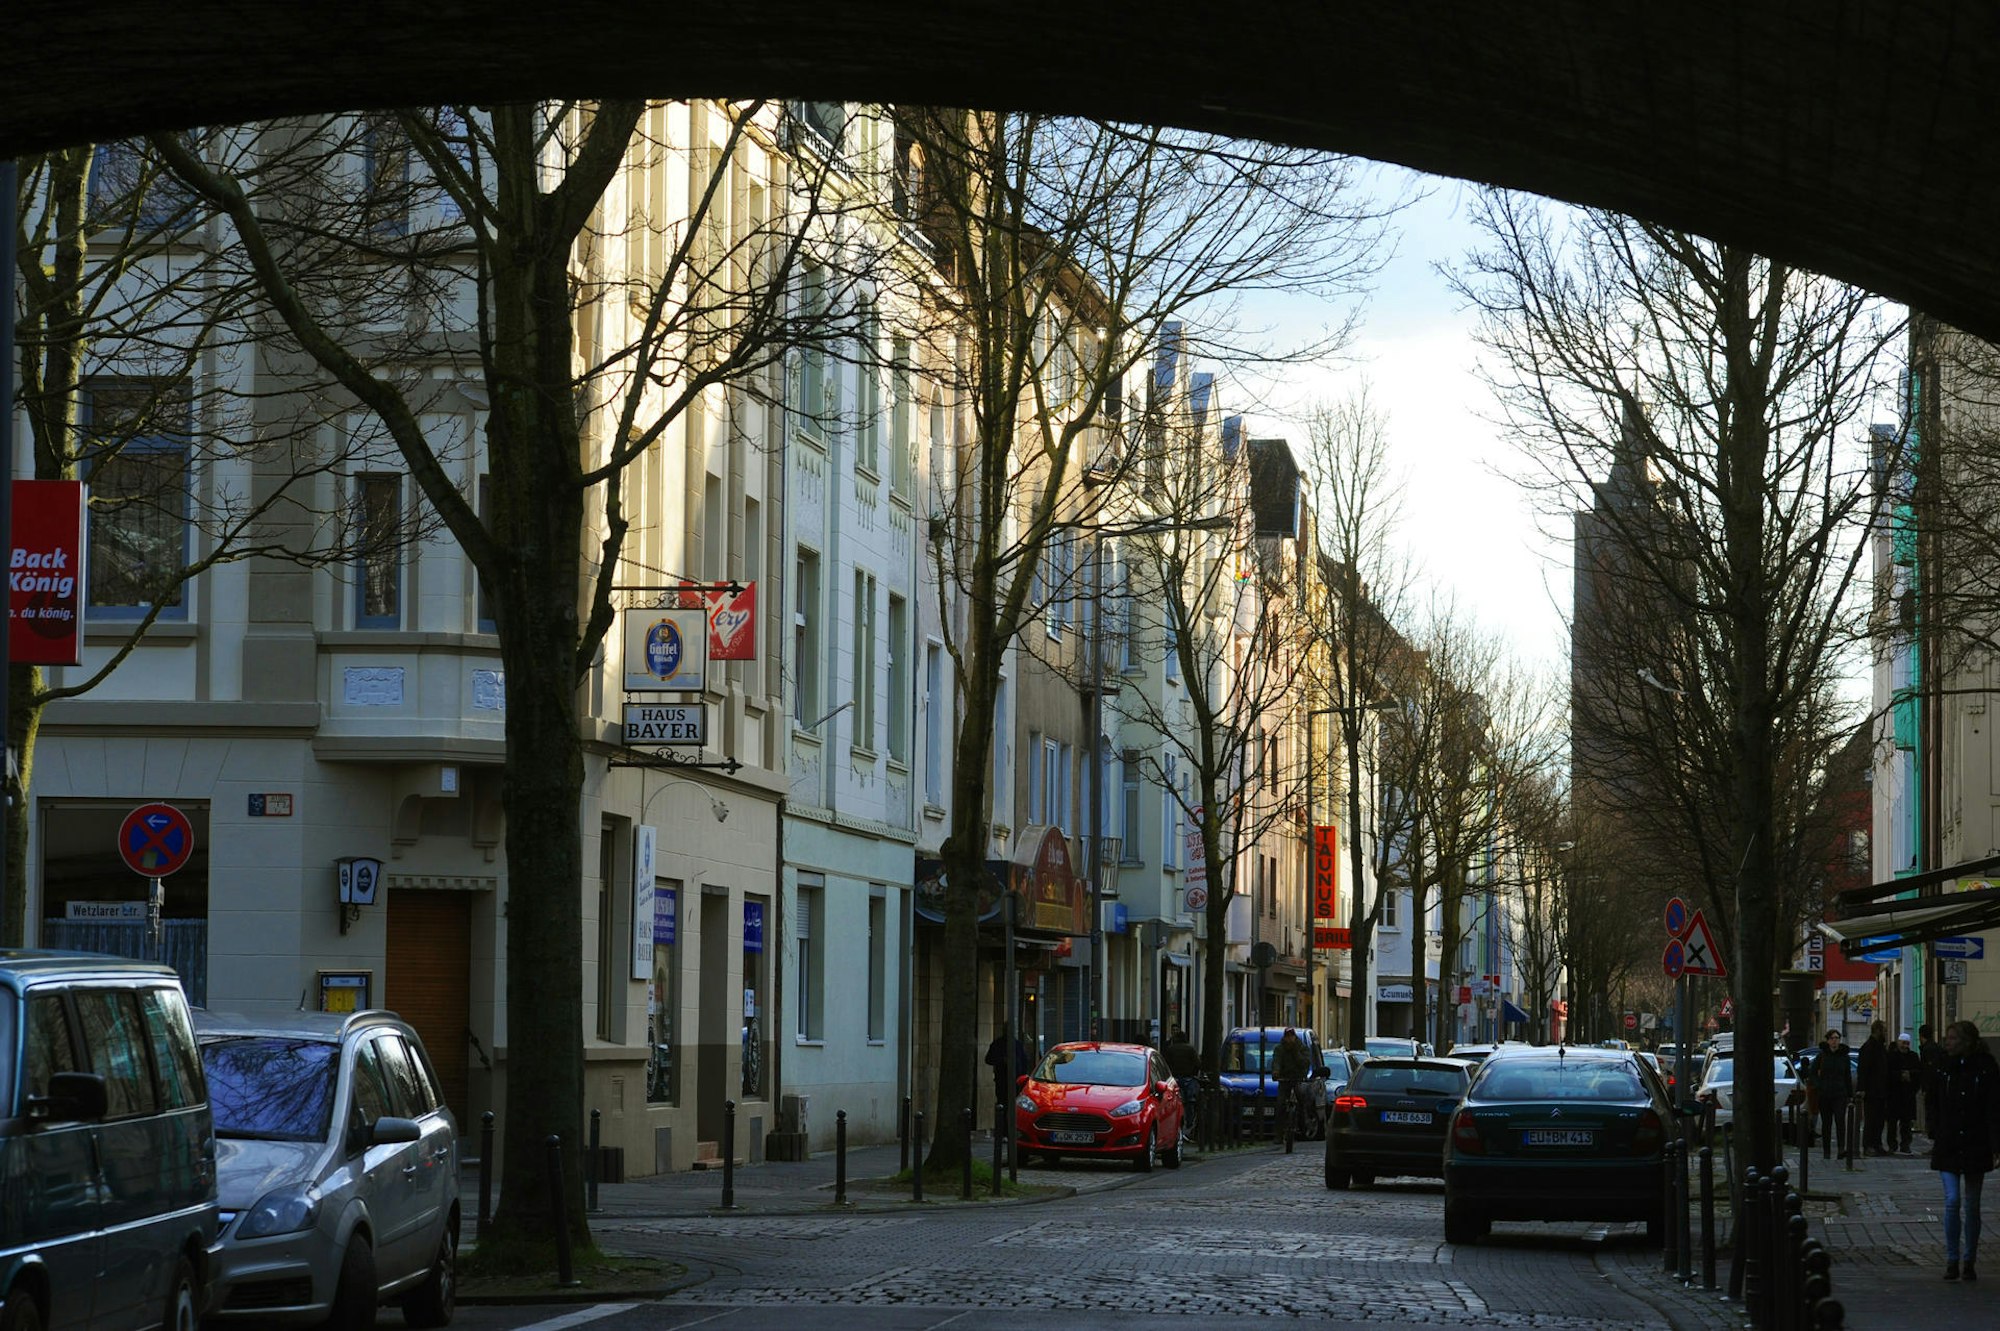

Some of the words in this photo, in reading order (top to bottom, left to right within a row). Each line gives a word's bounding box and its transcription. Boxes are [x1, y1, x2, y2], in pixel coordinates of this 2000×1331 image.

[10, 547, 67, 569] Back
[9, 571, 74, 599] König
[20, 607, 36, 618] du
[38, 607, 74, 621] könig.
[649, 643, 678, 655] Gaffel
[641, 709, 686, 721] HAUS
[627, 723, 699, 739] BAYER
[1318, 828, 1332, 916] TAUNUS
[73, 904, 119, 917] Wetzlarer
[1529, 1132, 1545, 1143] EU
[1571, 1132, 1592, 1143] 413
